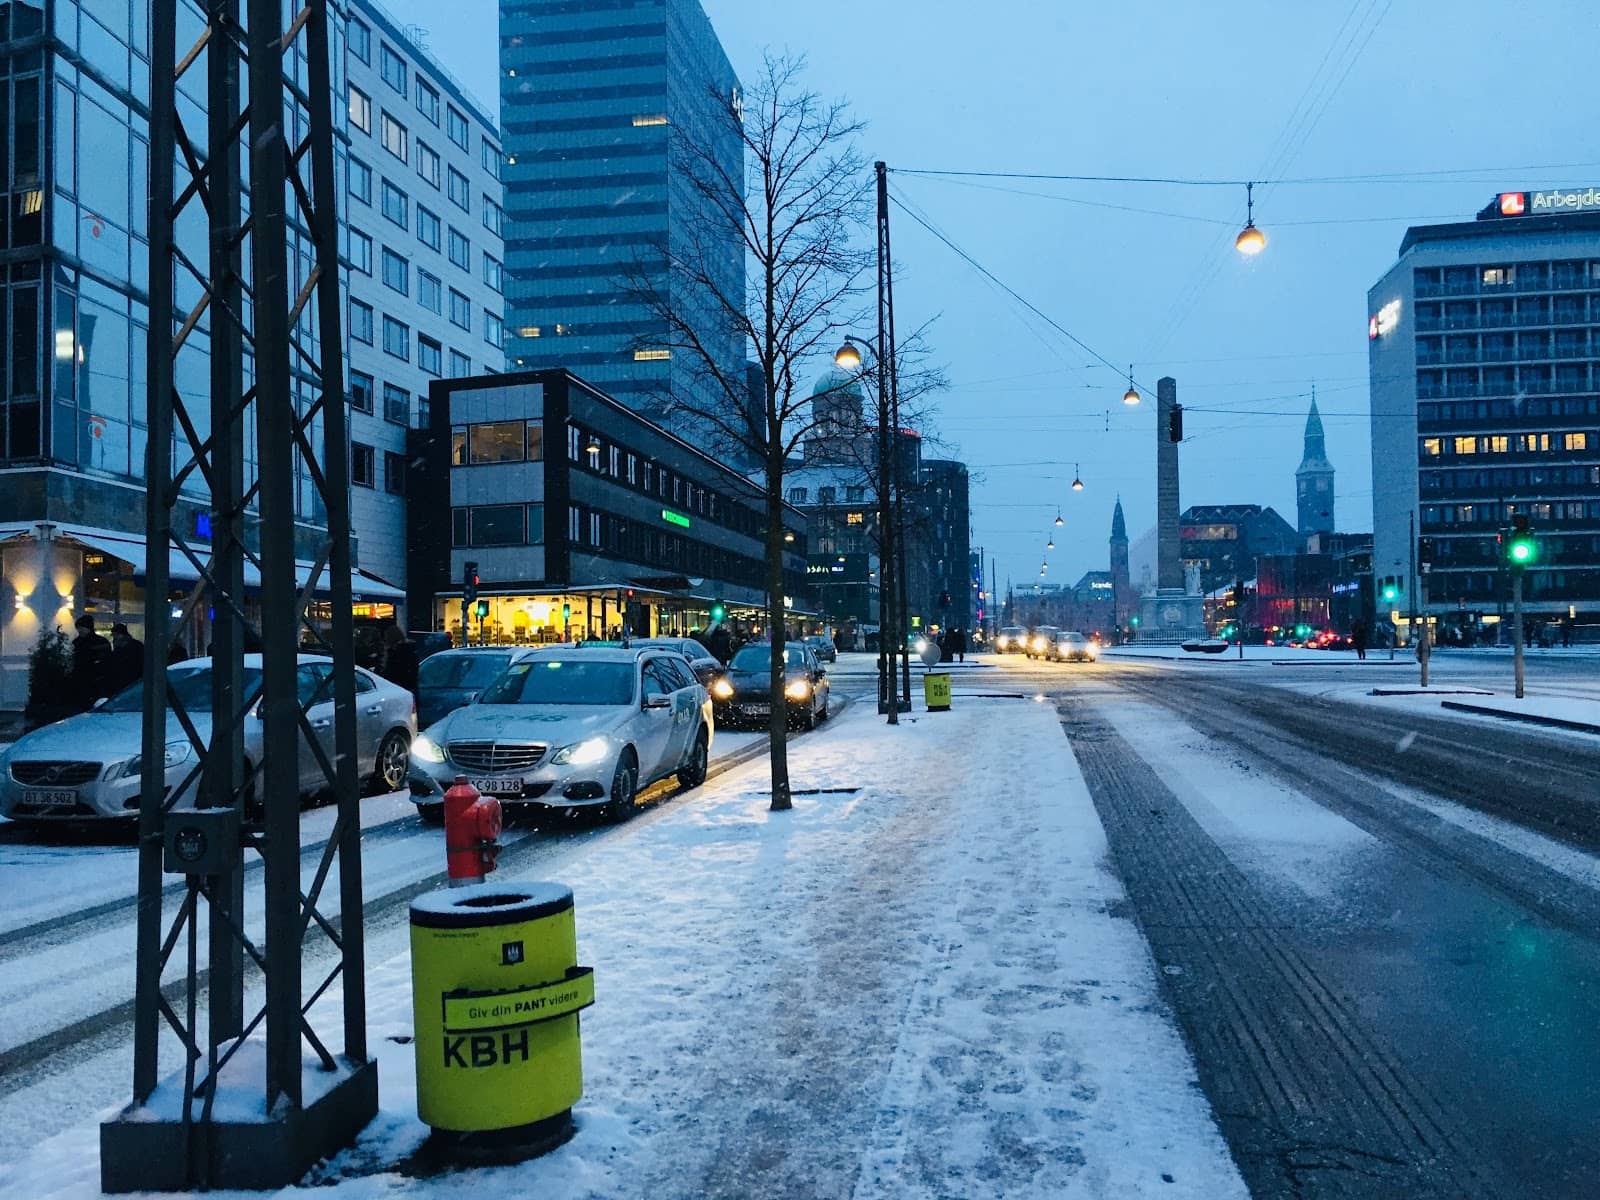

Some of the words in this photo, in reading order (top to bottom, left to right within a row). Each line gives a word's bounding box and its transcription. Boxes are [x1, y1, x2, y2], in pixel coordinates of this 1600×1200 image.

[485, 780, 498, 791] 98
[500, 780, 520, 791] 128
[469, 1007, 488, 1019] Giv
[491, 1004, 511, 1018] din
[514, 998, 547, 1013] PANT
[549, 990, 579, 1006] videre
[443, 1029, 529, 1068] KBH
